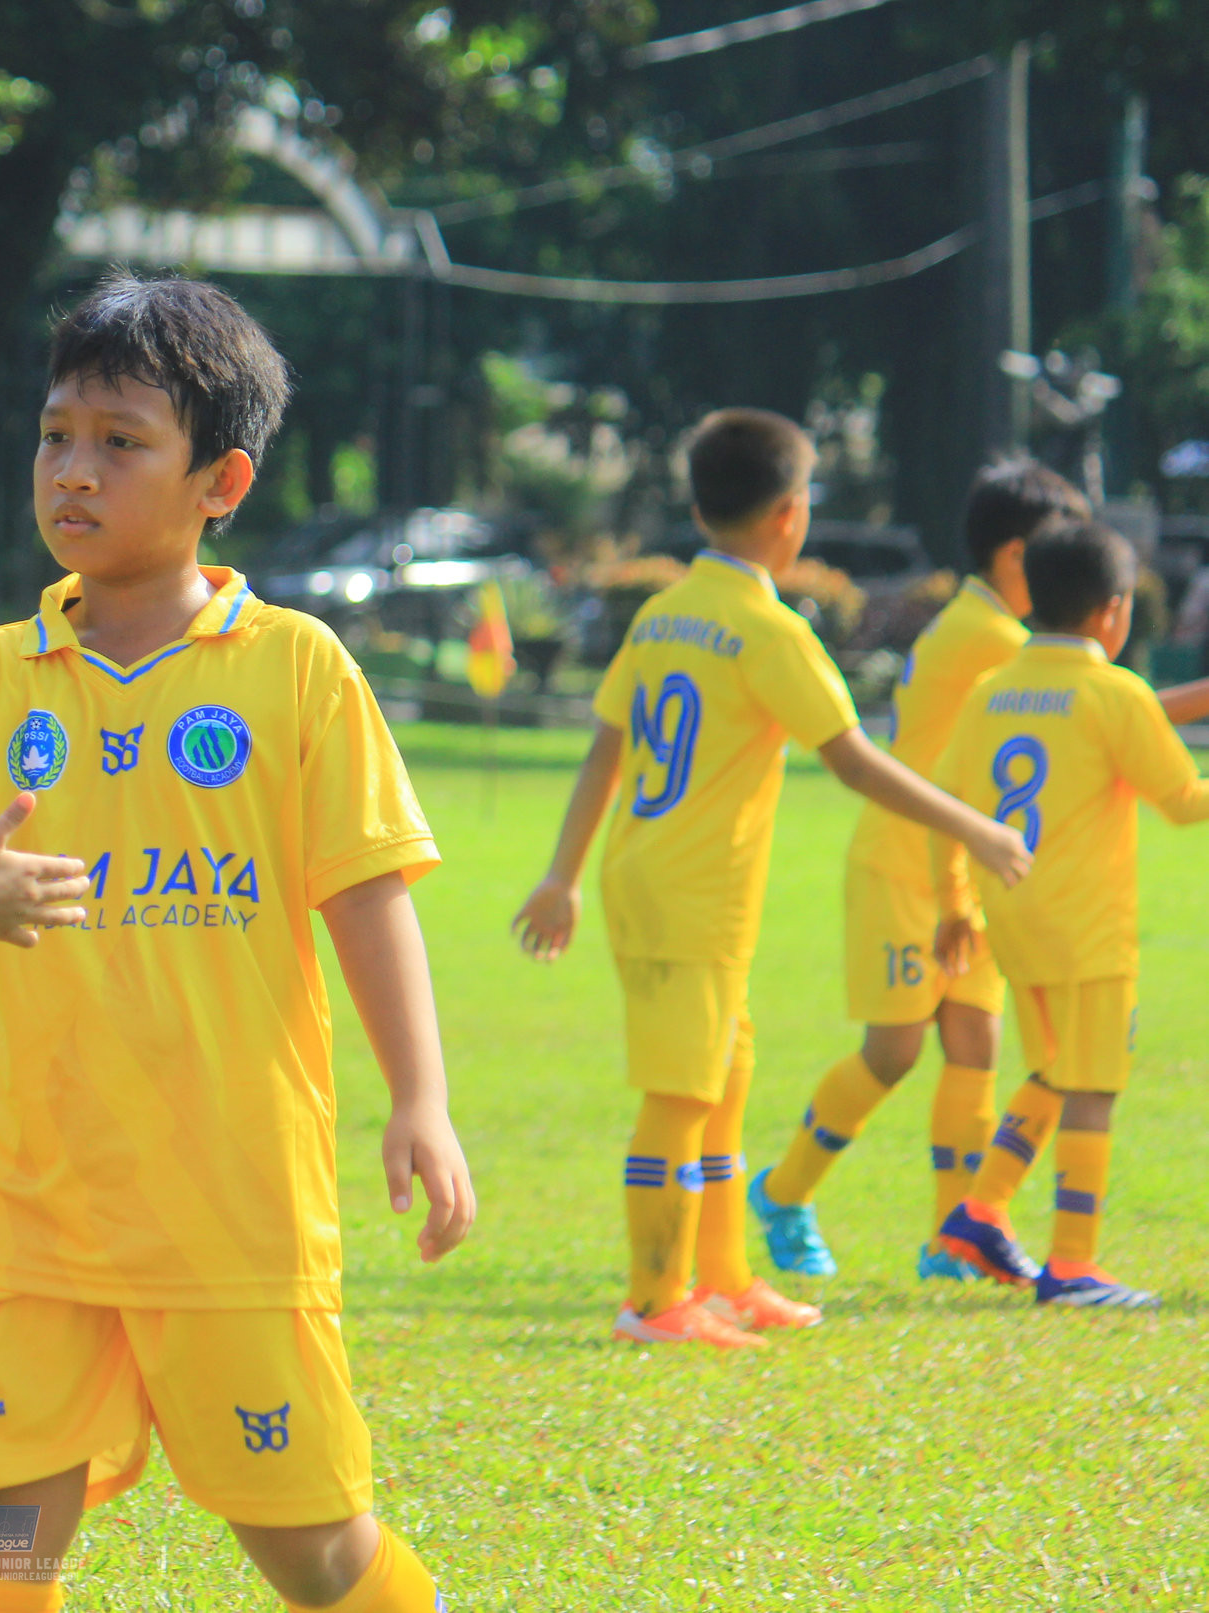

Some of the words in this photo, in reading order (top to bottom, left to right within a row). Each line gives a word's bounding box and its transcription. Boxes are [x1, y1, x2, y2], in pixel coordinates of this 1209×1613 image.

[24, 730, 49, 742] PSSI
[177, 710, 205, 730] PAM
[211, 710, 243, 733] JAYA
[175, 756, 210, 783] FOOTBALL
[211, 758, 243, 782] ACADEMY
[991, 734, 1049, 855] 8
[132, 847, 260, 903] JAYA
[121, 904, 258, 933] ACADEMY
[884, 941, 924, 989] 16
